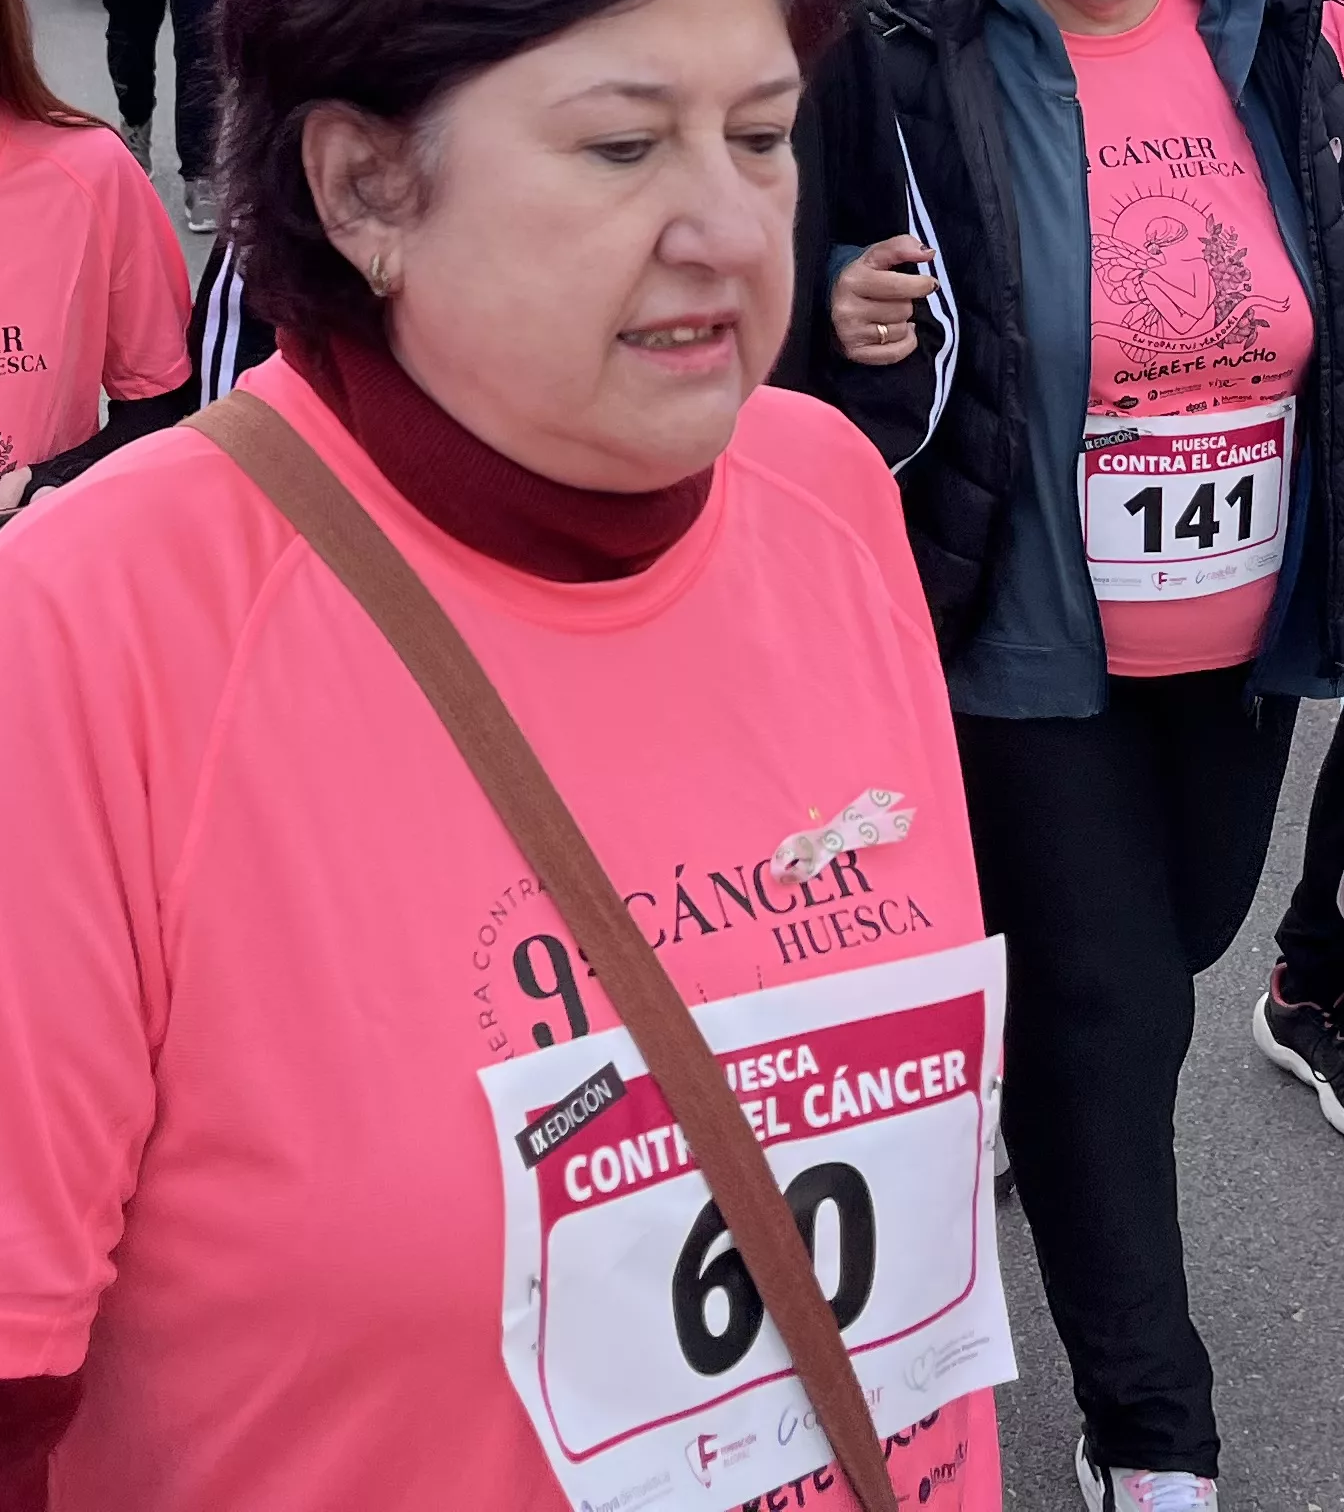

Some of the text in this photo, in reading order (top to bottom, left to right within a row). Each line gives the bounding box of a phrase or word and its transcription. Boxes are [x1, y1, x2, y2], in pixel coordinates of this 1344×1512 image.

[1098, 136, 1217, 168] CÁNCER
[1168, 160, 1246, 179] HUESCA
[1113, 354, 1207, 385] QUIÉRETE
[1211, 347, 1278, 369] MUCHO
[1093, 432, 1133, 449] EDICIÓN
[1097, 440, 1278, 473] CONTRA EL CÁNCER
[1171, 435, 1228, 453] HUESCA
[1123, 473, 1255, 554] 141
[771, 894, 934, 966] HUESCA
[527, 1076, 614, 1157] IX EDICIÓN
[563, 1048, 969, 1204] CONTR EL CÁNCER
[671, 1160, 877, 1377] 60
